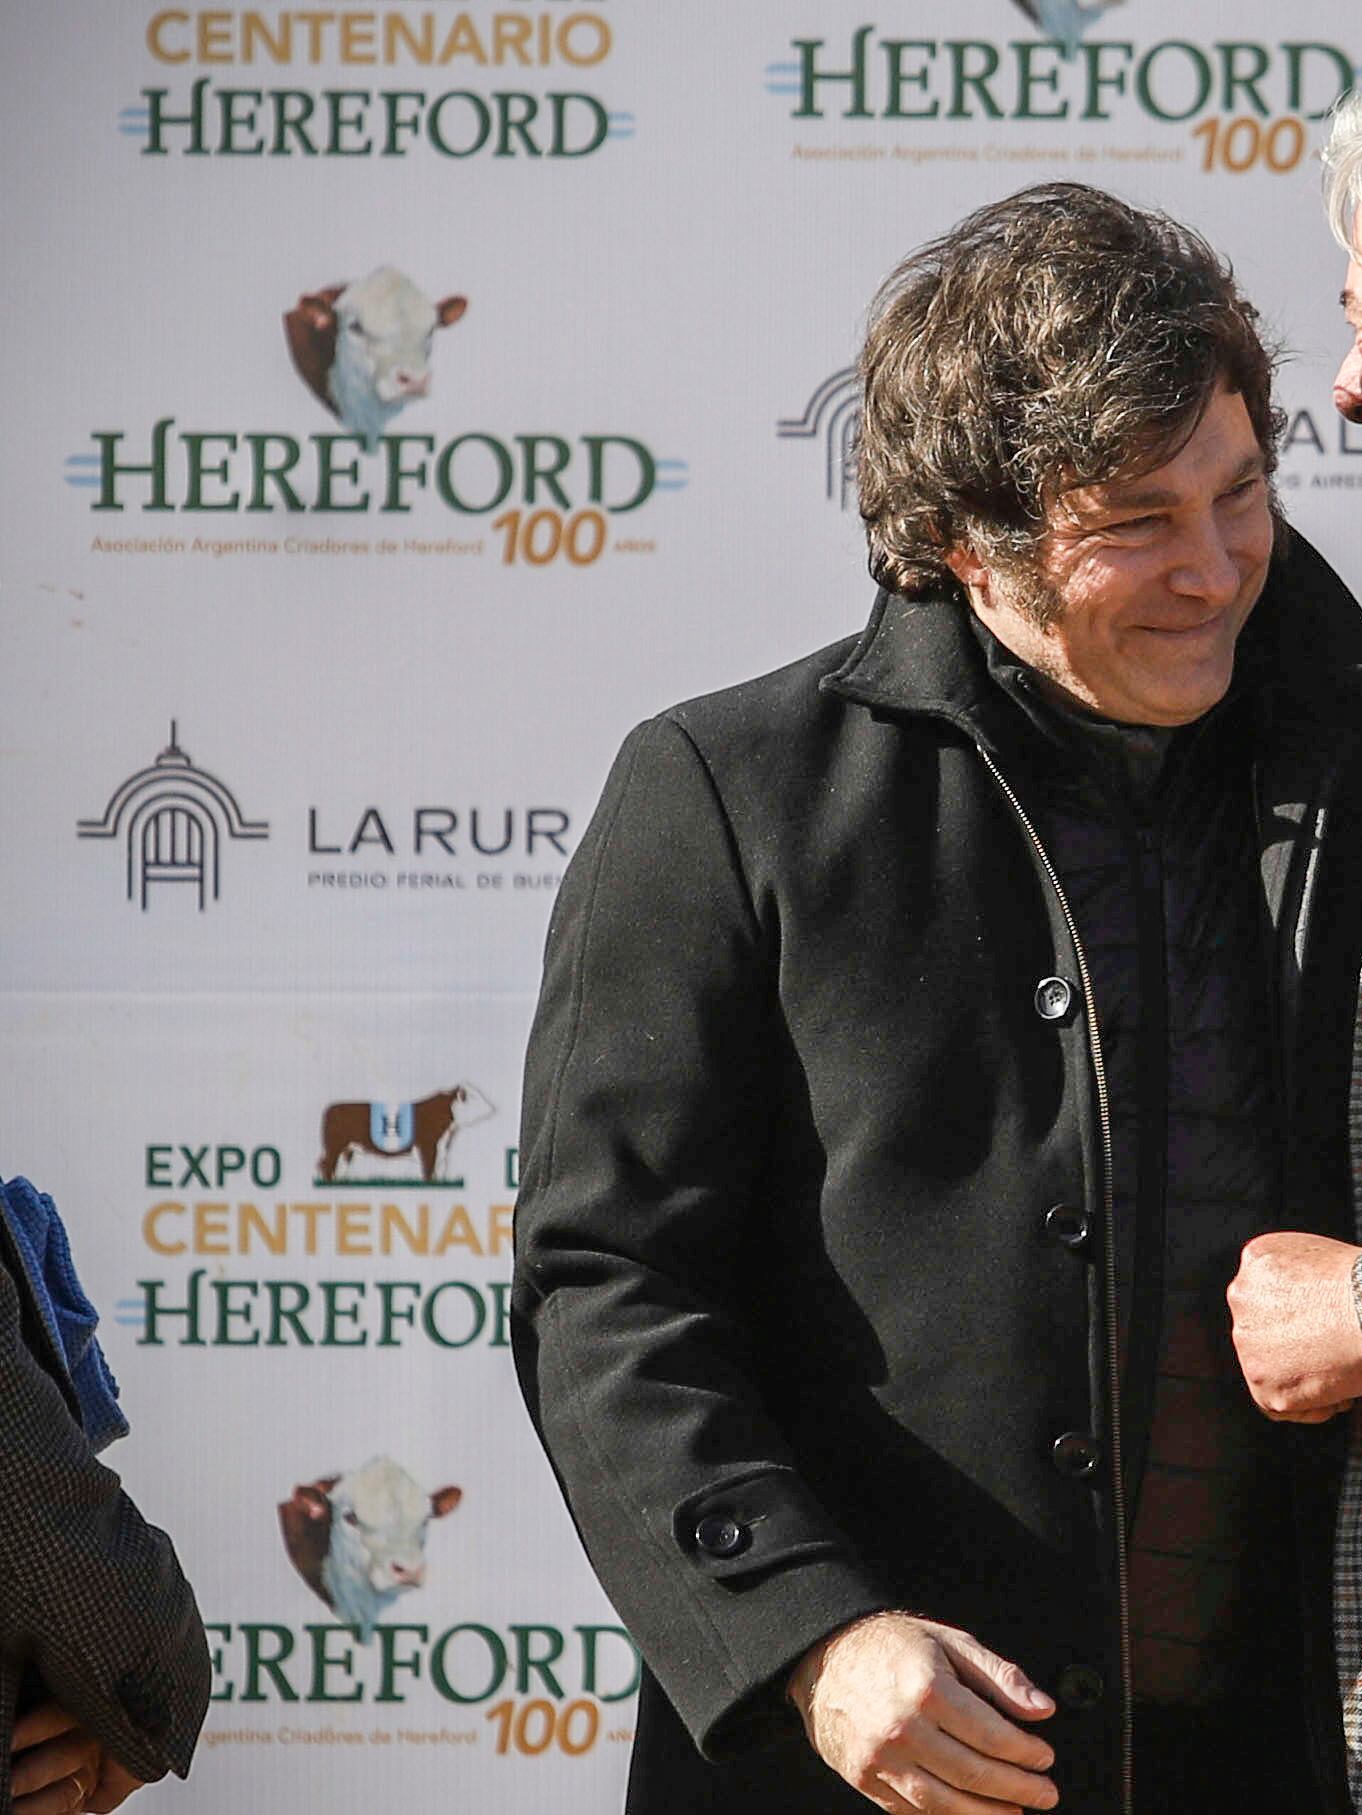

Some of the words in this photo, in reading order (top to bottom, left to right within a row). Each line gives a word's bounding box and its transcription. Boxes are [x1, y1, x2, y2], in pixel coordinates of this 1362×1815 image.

[145, 11, 613, 67] CENTENARIO
[791, 25, 1355, 120] HEREFORD
[141, 76, 608, 159] HEREFORD
[1191, 116, 1307, 174] 100
[89, 418, 657, 515] HEREFORD
[490, 508, 607, 568] 100
[307, 871, 386, 889] PREDIO
[396, 871, 466, 889] FERIAL
[476, 871, 502, 889] DE
[146, 1145, 283, 1189] EXPO
[142, 1202, 514, 1258] CENTENAR
[136, 1268, 512, 1348] HEREFO
[203, 1622, 643, 1703] EREFORD
[201, 1731, 273, 1749] gentina
[485, 1698, 601, 1756] 100
